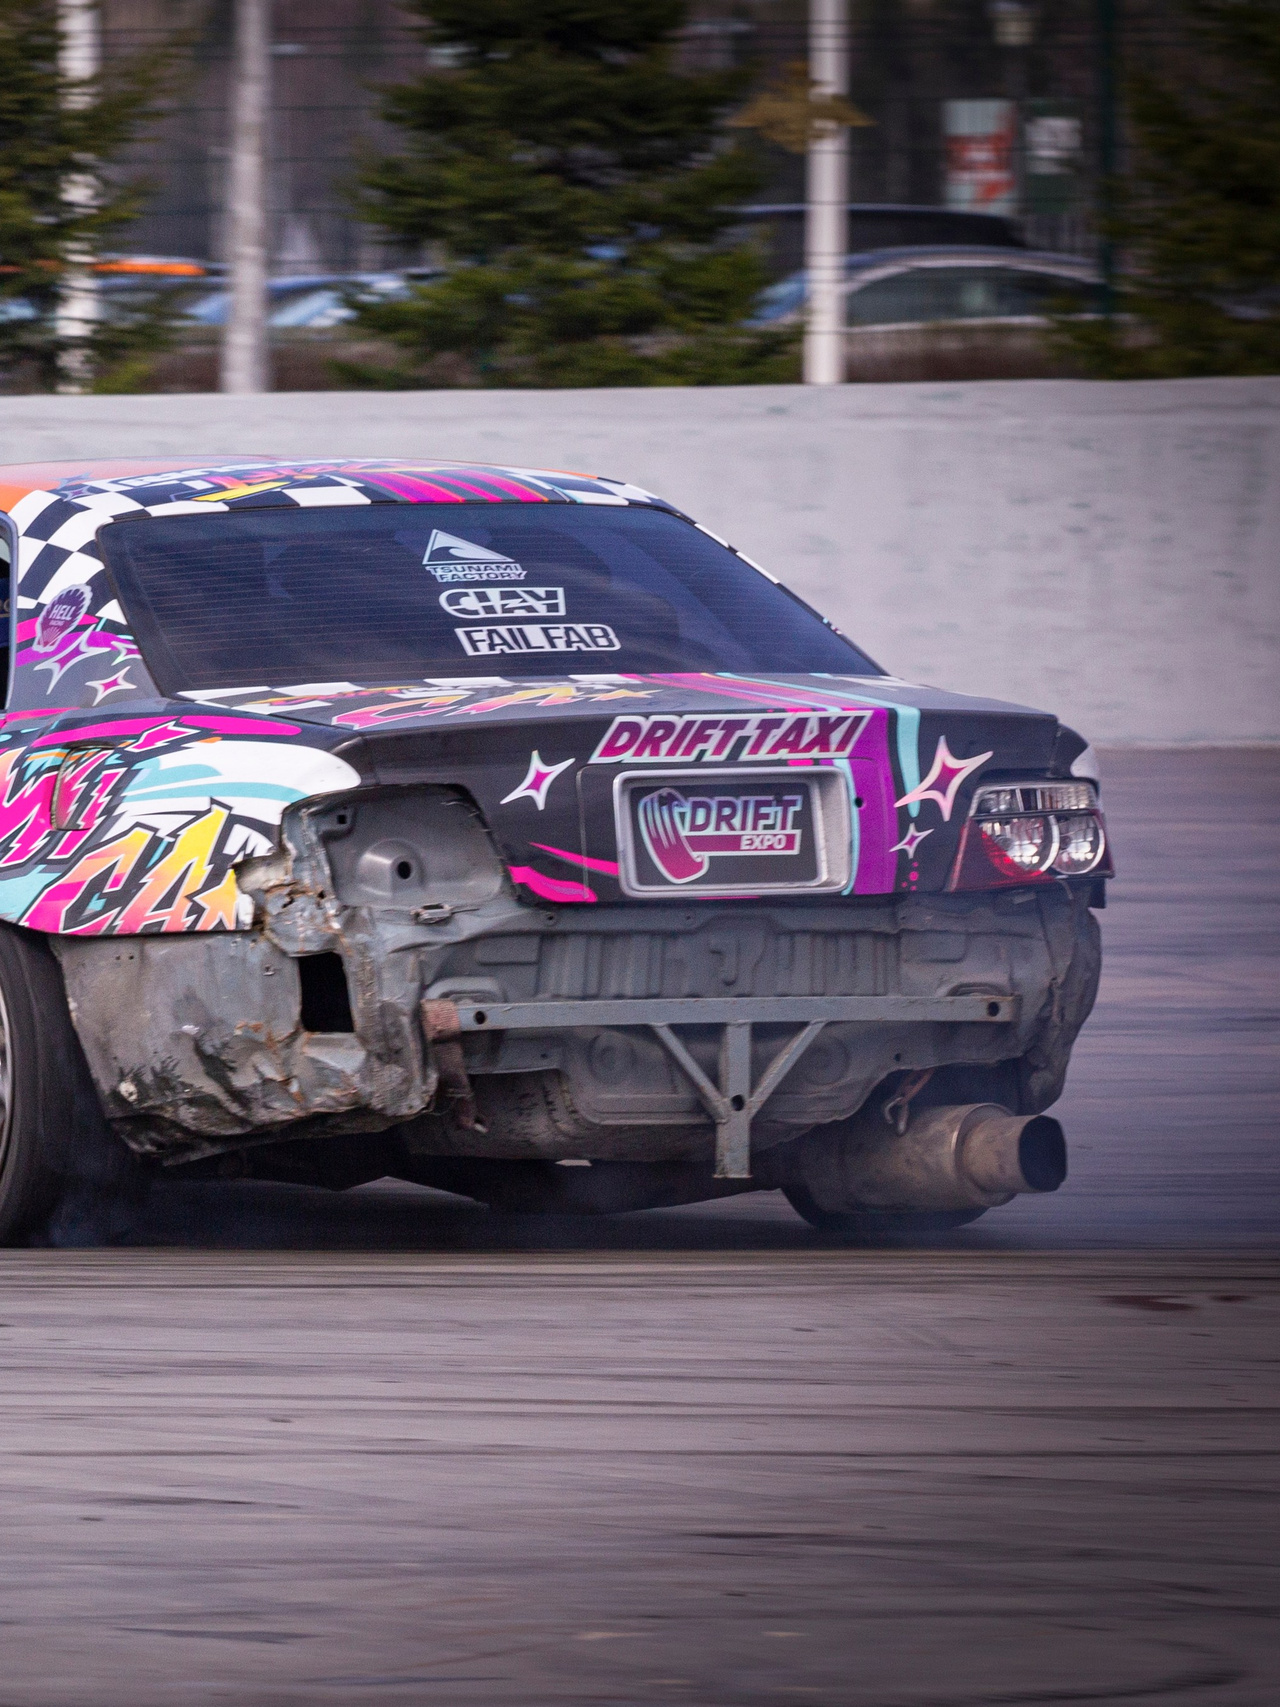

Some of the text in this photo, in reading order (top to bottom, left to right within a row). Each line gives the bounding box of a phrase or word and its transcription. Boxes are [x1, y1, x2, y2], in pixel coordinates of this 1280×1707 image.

[427, 565, 522, 574] TSUNAMI
[438, 572, 527, 582] FACTORY
[48, 604, 77, 621] HELL
[688, 797, 801, 832] DRIFT
[740, 834, 786, 850] EXPO
